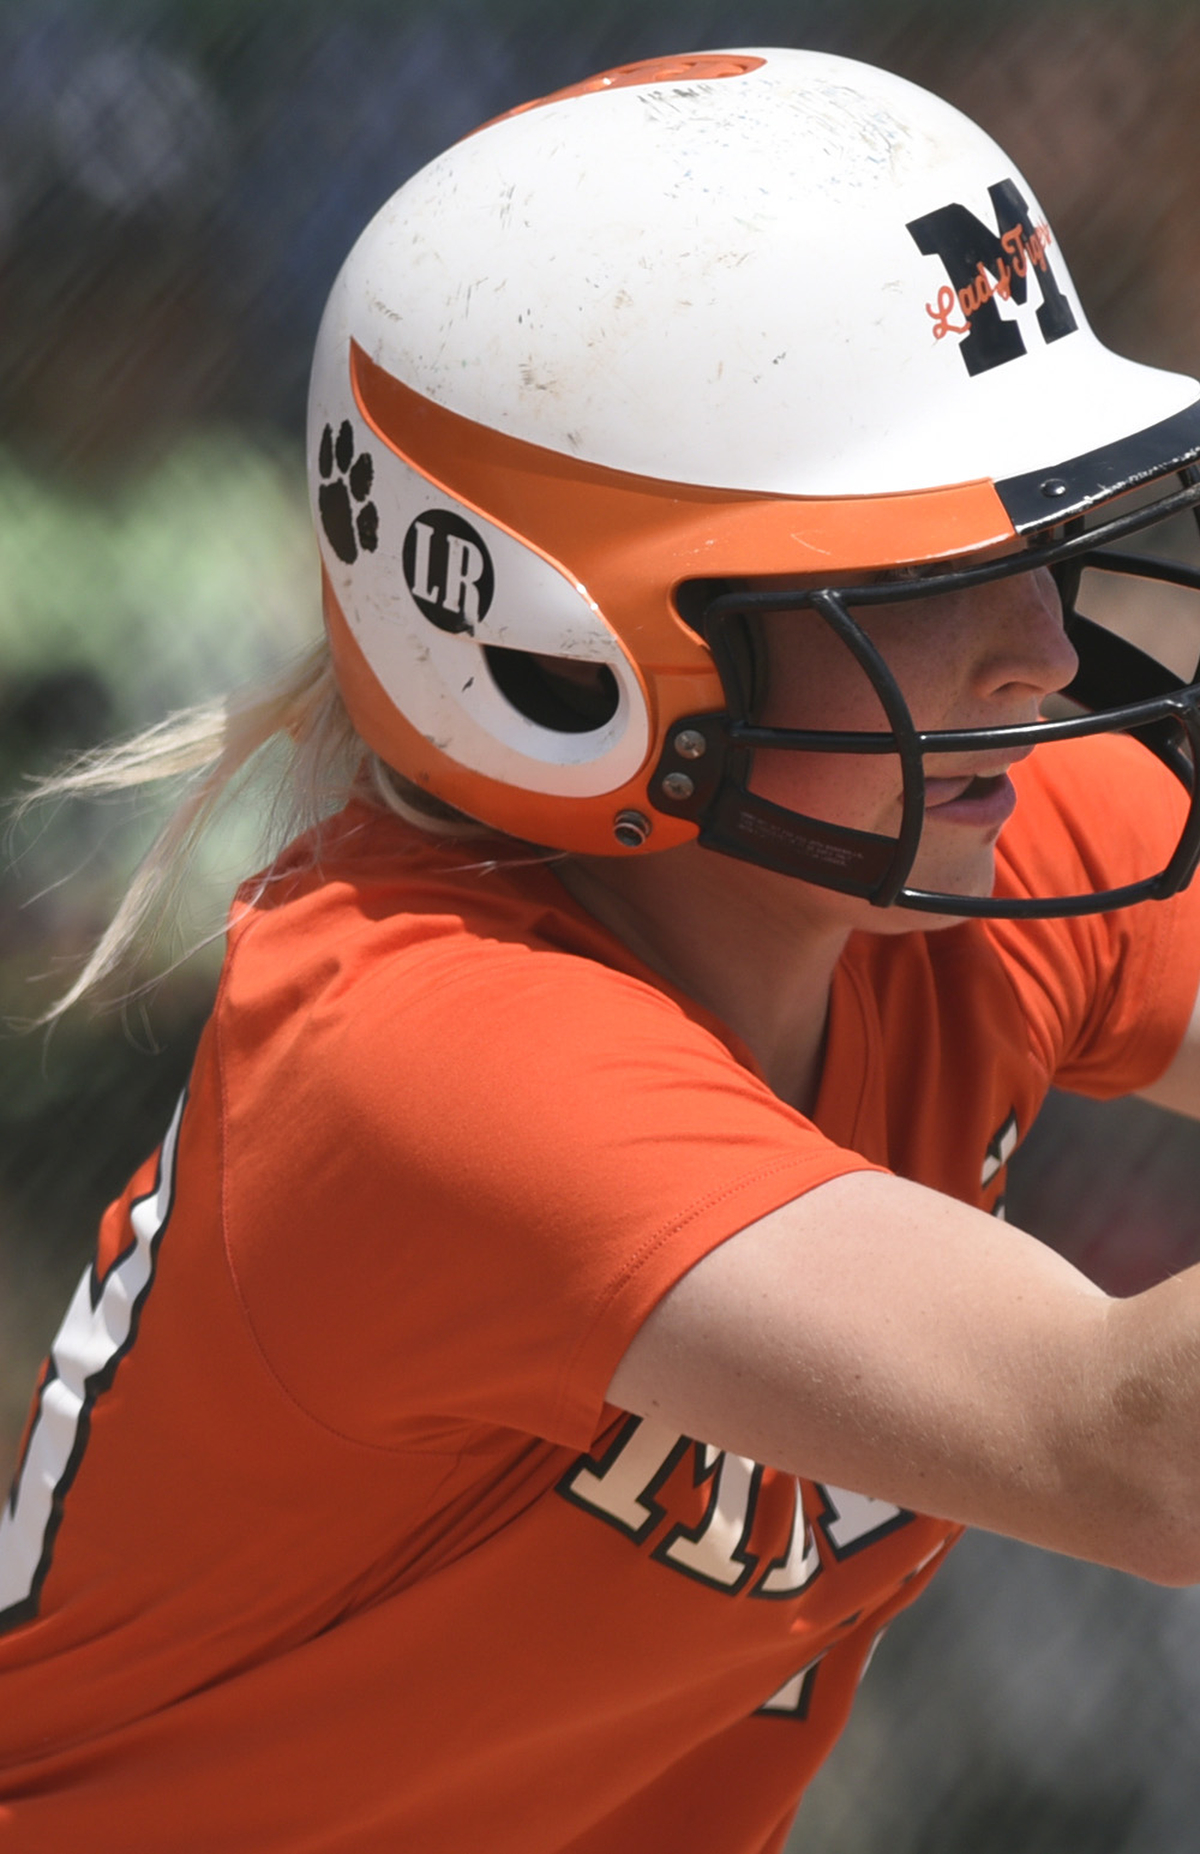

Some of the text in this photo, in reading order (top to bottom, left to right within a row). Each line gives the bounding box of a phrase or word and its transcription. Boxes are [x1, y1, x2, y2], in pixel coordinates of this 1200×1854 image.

[905, 178, 1079, 377] M
[925, 257, 1011, 340] Lady
[411, 522, 484, 623] LR
